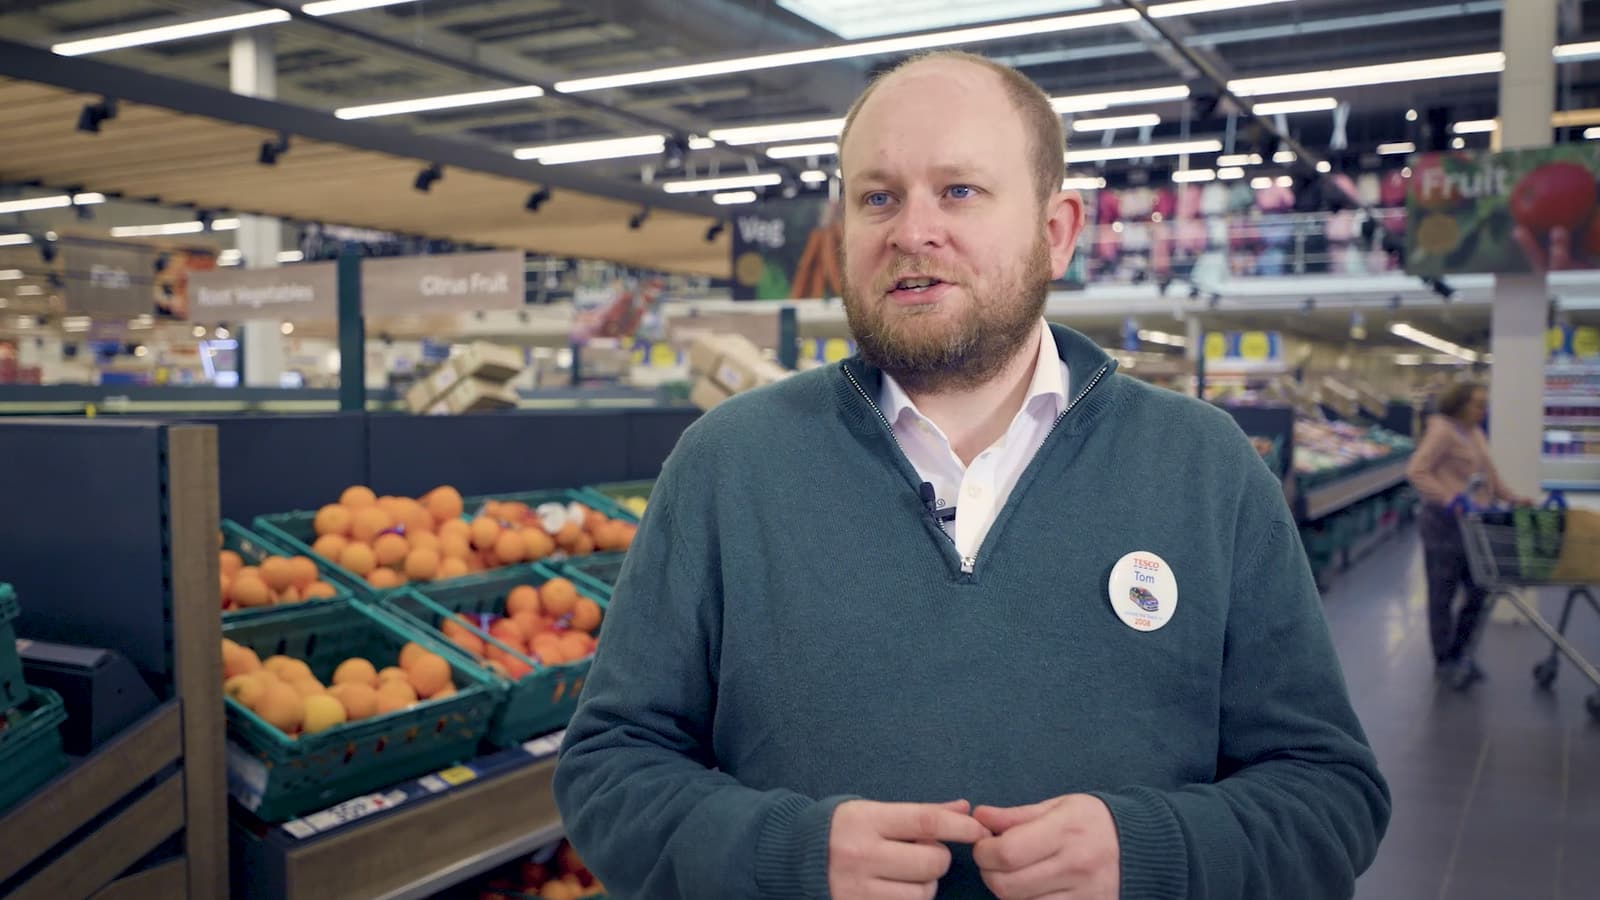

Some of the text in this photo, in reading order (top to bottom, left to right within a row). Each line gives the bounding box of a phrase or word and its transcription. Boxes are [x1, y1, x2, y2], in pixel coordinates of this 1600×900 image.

[1422, 163, 1508, 199] Fruit
[738, 216, 785, 249] Veg
[235, 283, 314, 308] Vegetables
[420, 272, 509, 296] Citrus Fruit
[1133, 558, 1160, 569] TESCO
[1134, 570, 1155, 584] Tom
